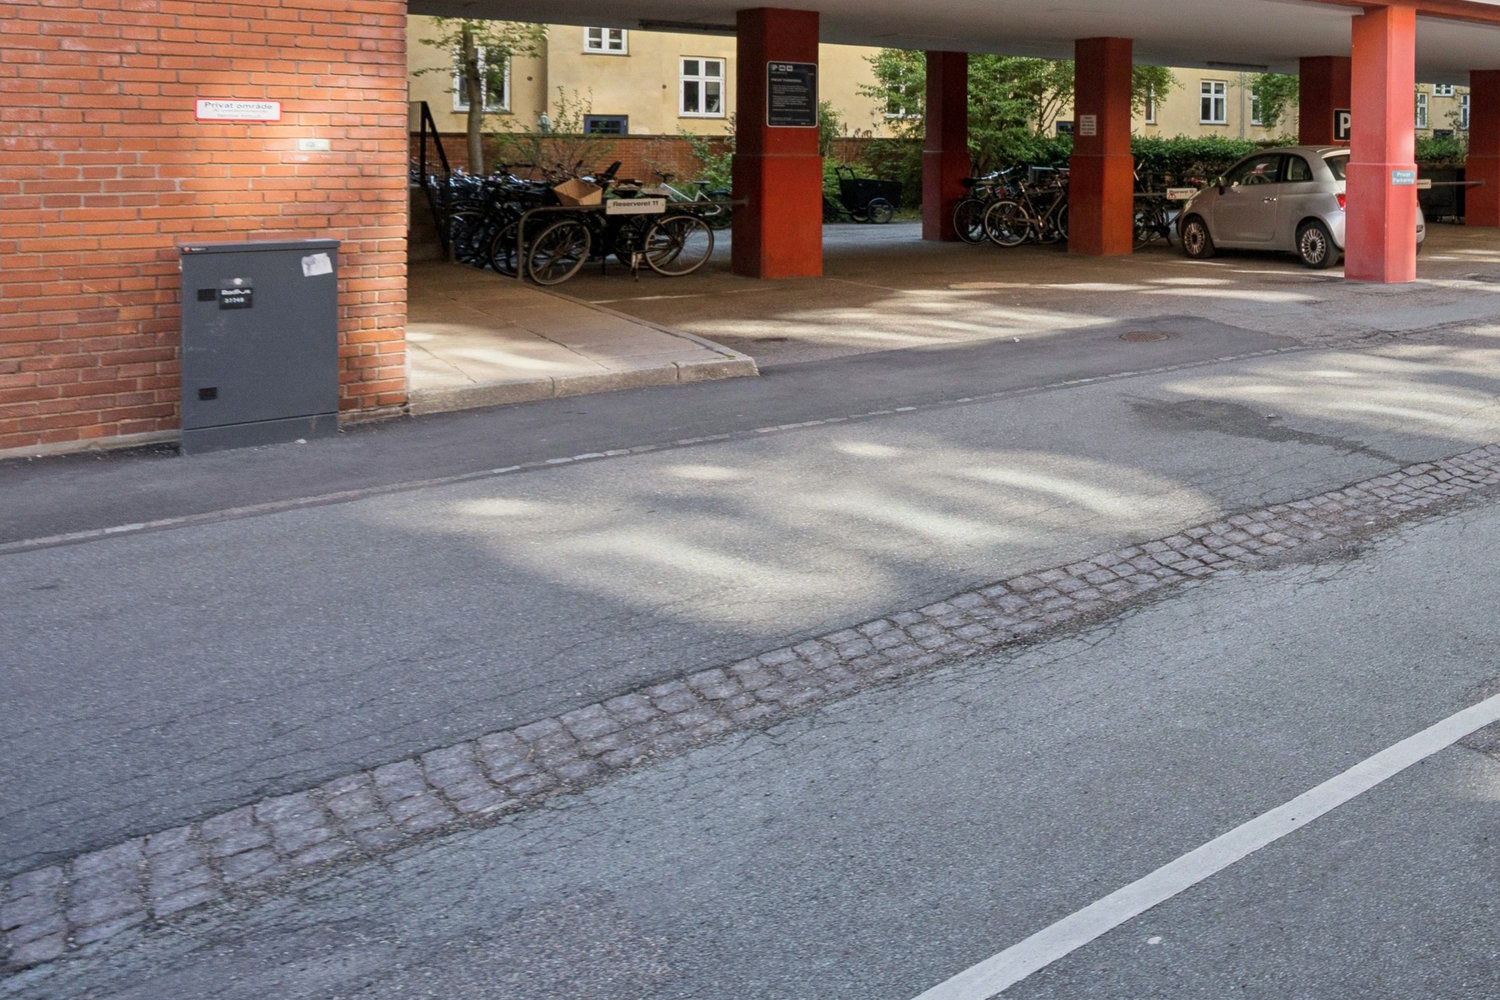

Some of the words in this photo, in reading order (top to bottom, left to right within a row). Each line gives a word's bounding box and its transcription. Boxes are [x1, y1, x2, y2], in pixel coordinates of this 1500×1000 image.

[204, 101, 234, 109] Privat
[236, 102, 273, 110] område
[1339, 112, 1351, 138] P
[612, 200, 650, 208] Reserveret
